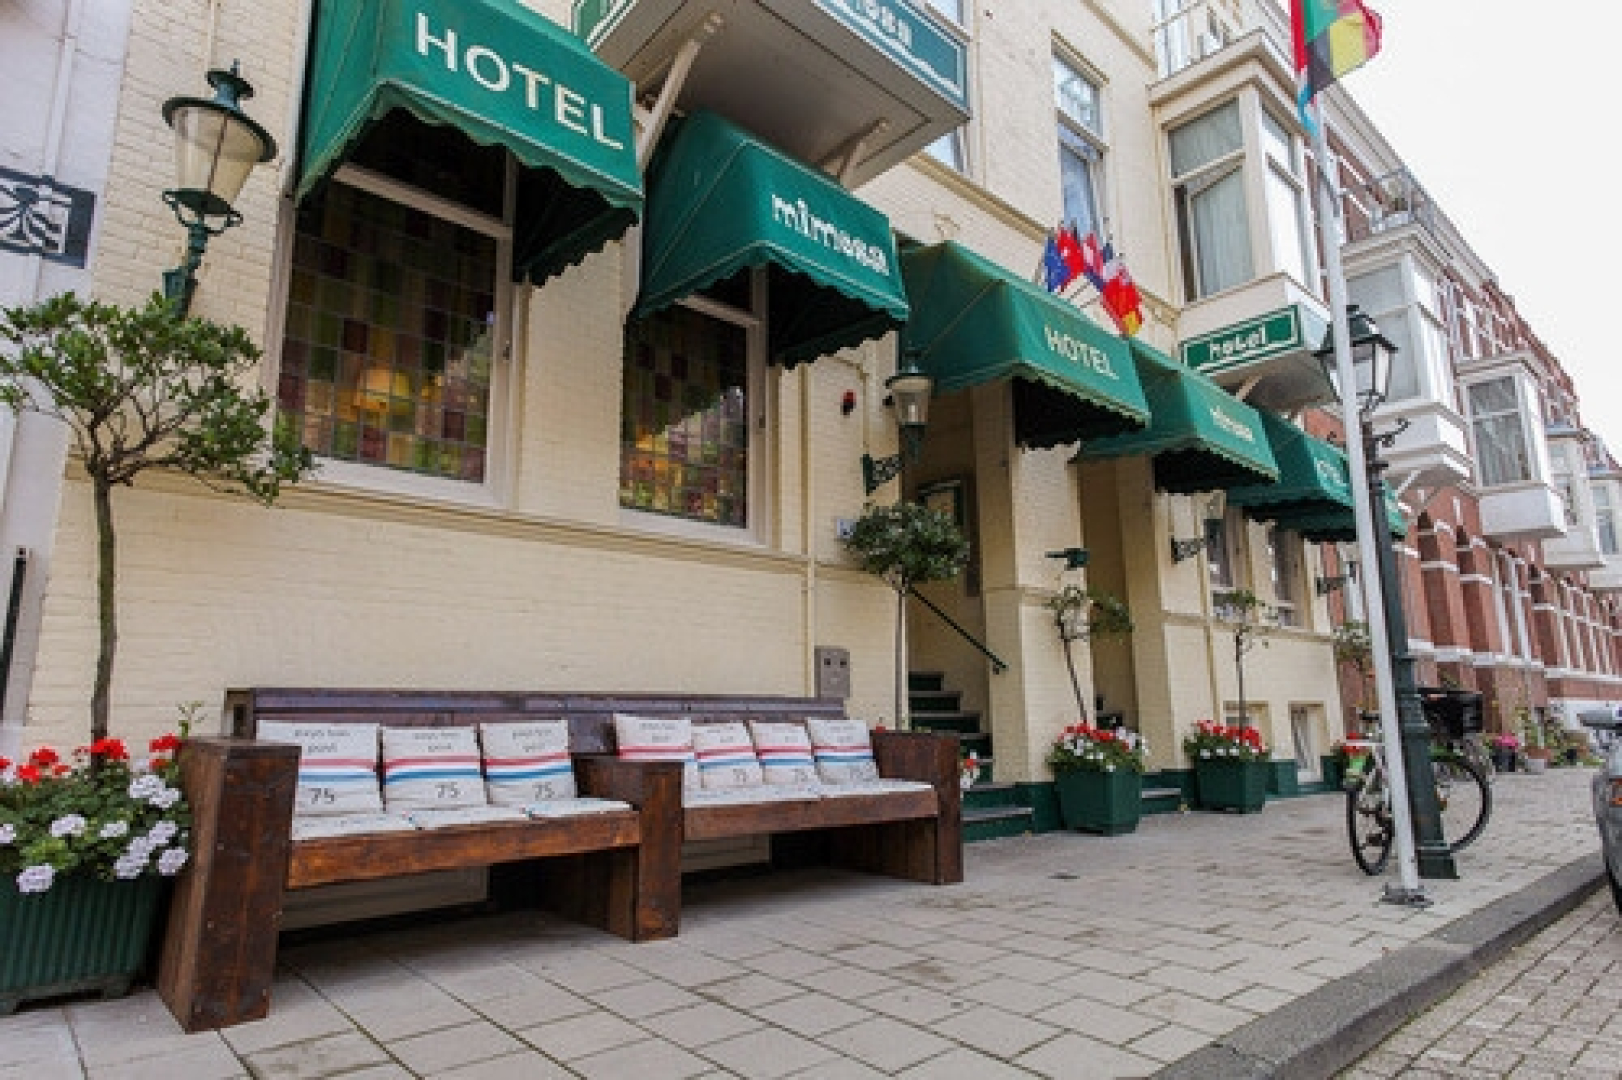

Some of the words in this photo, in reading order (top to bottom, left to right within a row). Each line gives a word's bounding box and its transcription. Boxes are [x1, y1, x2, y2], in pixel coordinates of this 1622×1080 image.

[414, 12, 625, 151] HOTEL
[771, 193, 889, 276] mimosa
[1044, 324, 1119, 380] HOTEL
[306, 786, 336, 805] 75
[434, 781, 462, 800] 75
[532, 781, 558, 800] 75
